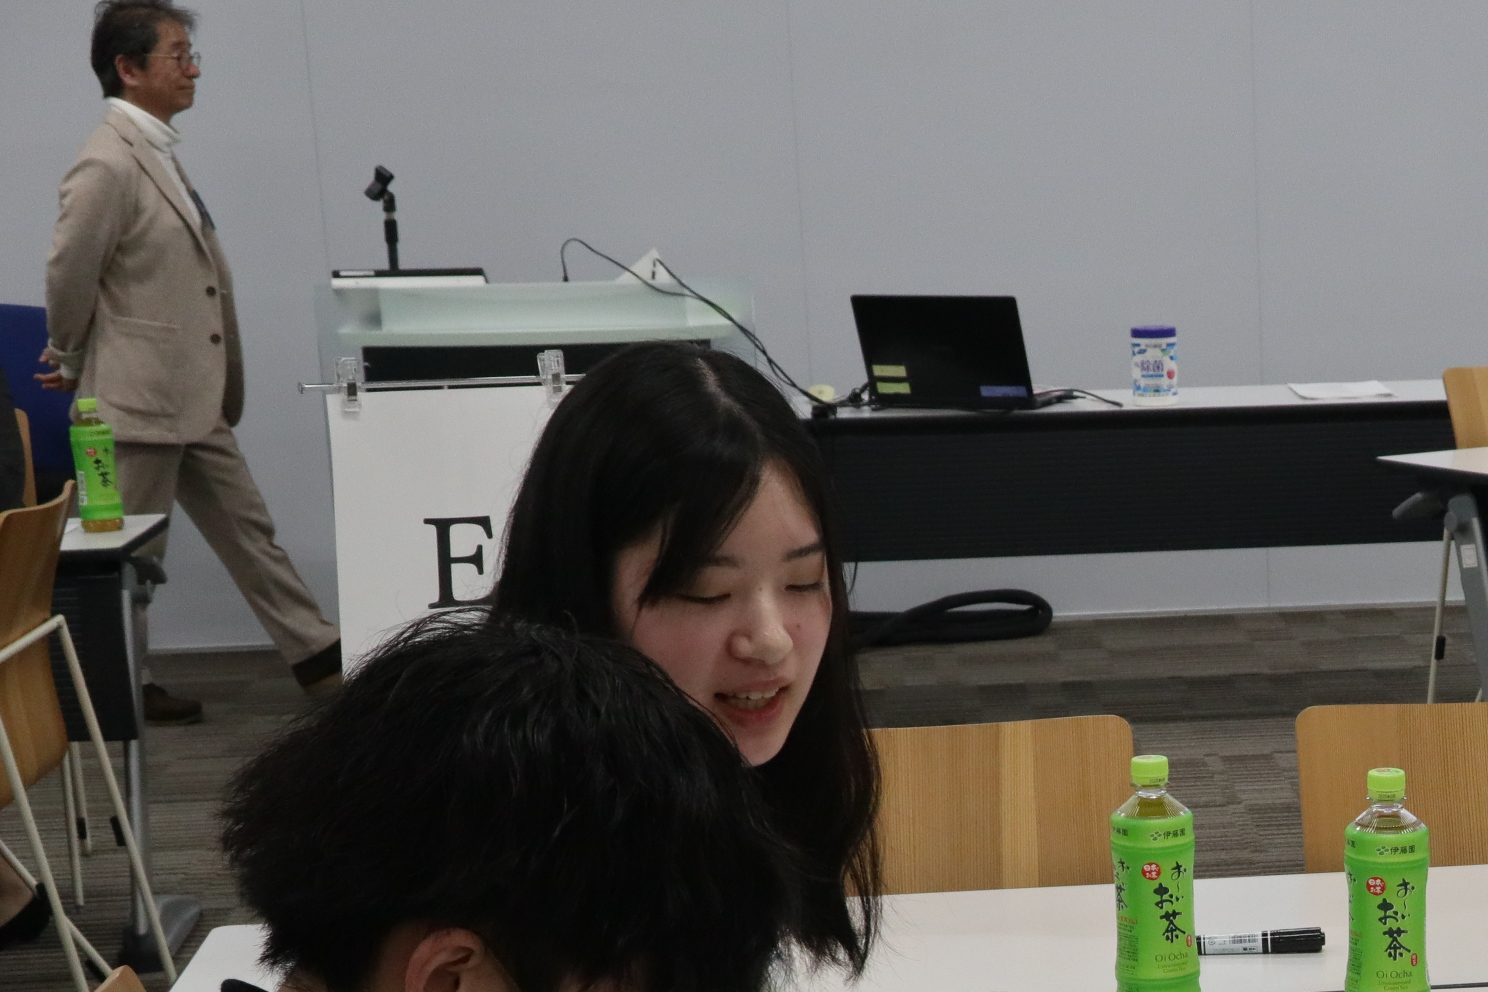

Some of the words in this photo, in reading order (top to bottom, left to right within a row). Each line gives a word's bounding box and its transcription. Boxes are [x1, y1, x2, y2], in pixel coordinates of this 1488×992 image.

[423, 515, 498, 609] E
[1162, 828, 1186, 840] 伊藤園
[1389, 845, 1416, 856] 伊藤園
[1153, 882, 1186, 943] お茶
[1377, 897, 1411, 961] お茶
[1154, 953, 1167, 962] Oi
[1168, 951, 1189, 962] Ocha
[1376, 971, 1388, 979] Oi
[1389, 969, 1413, 979] Ocha
